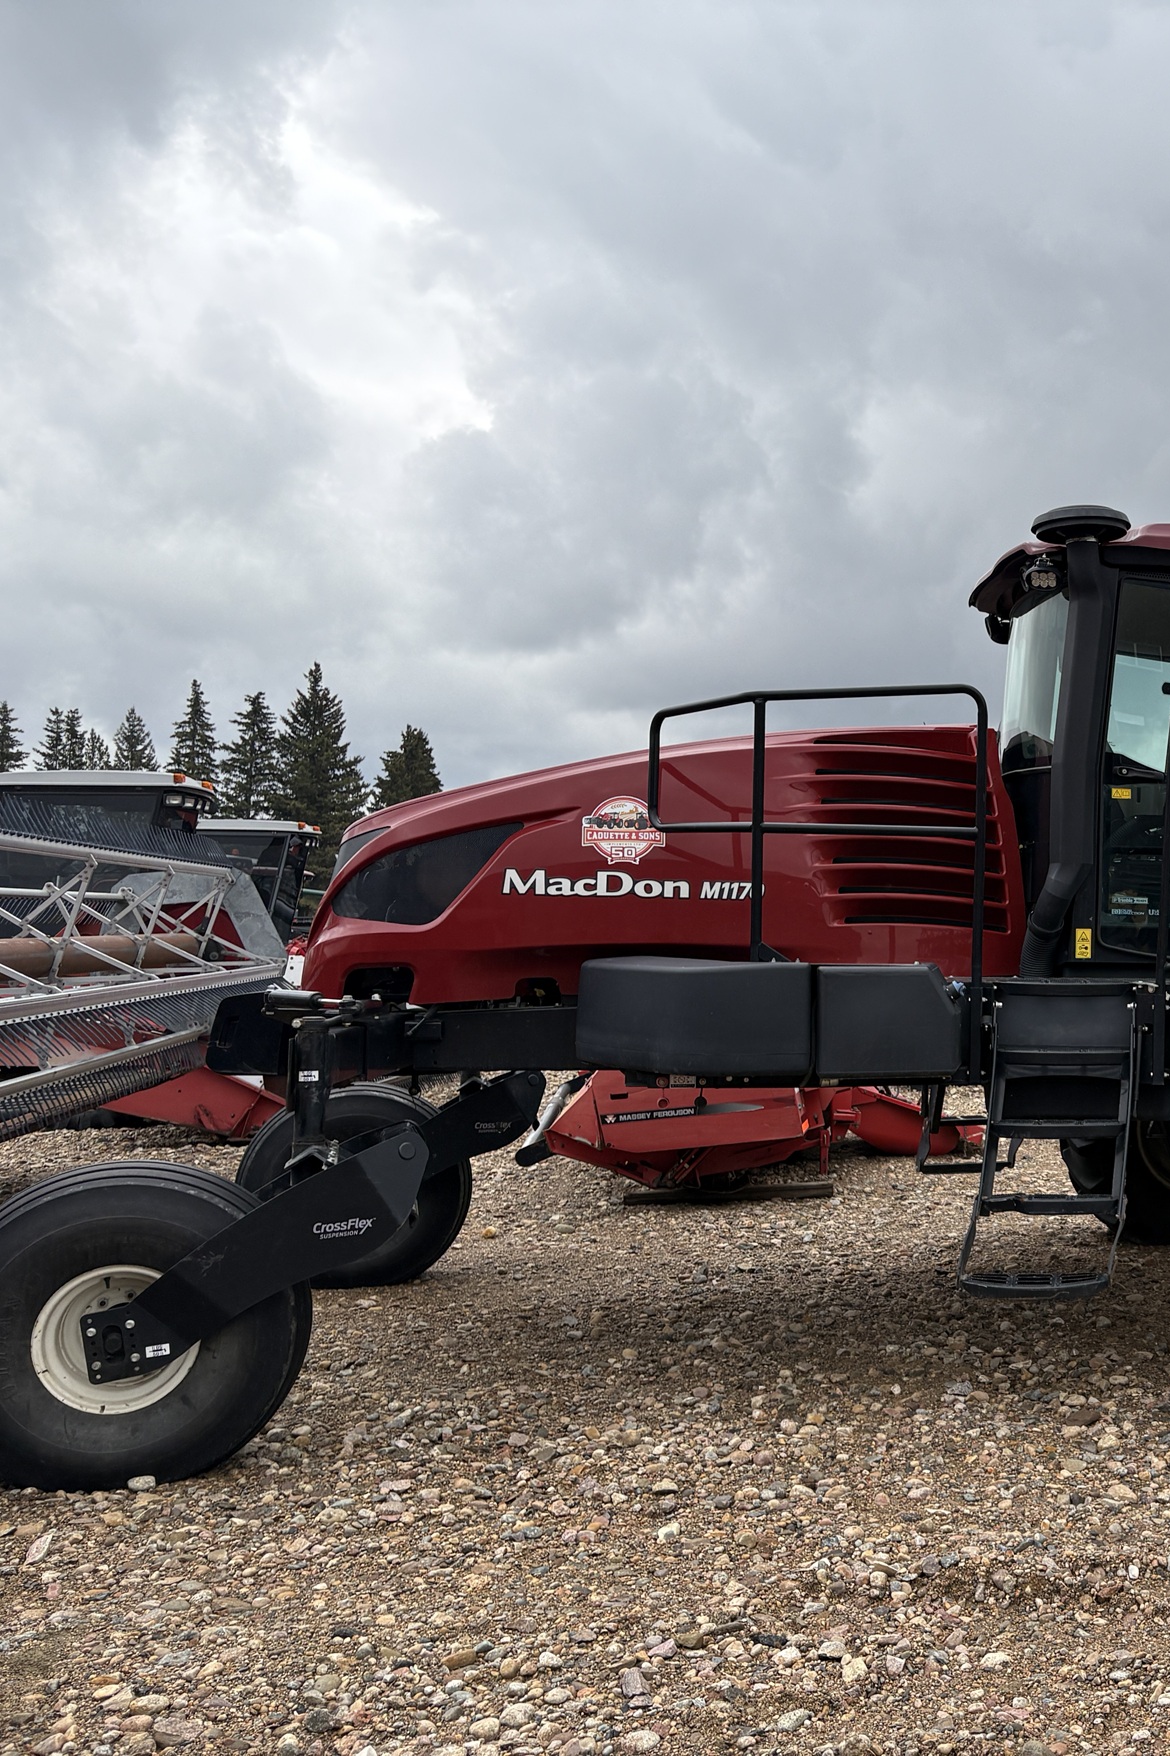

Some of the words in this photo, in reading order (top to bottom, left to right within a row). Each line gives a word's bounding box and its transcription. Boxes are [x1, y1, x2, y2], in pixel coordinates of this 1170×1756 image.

[631, 832, 636, 840] &
[638, 832, 660, 840] SONS
[611, 847, 636, 858] 50
[502, 868, 690, 898] MacDon
[619, 1111, 651, 1121] MASSEY
[653, 1108, 695, 1118] FERGUSON
[313, 1217, 374, 1234] CrossFlex
[319, 1230, 359, 1240] SUSPENSION
